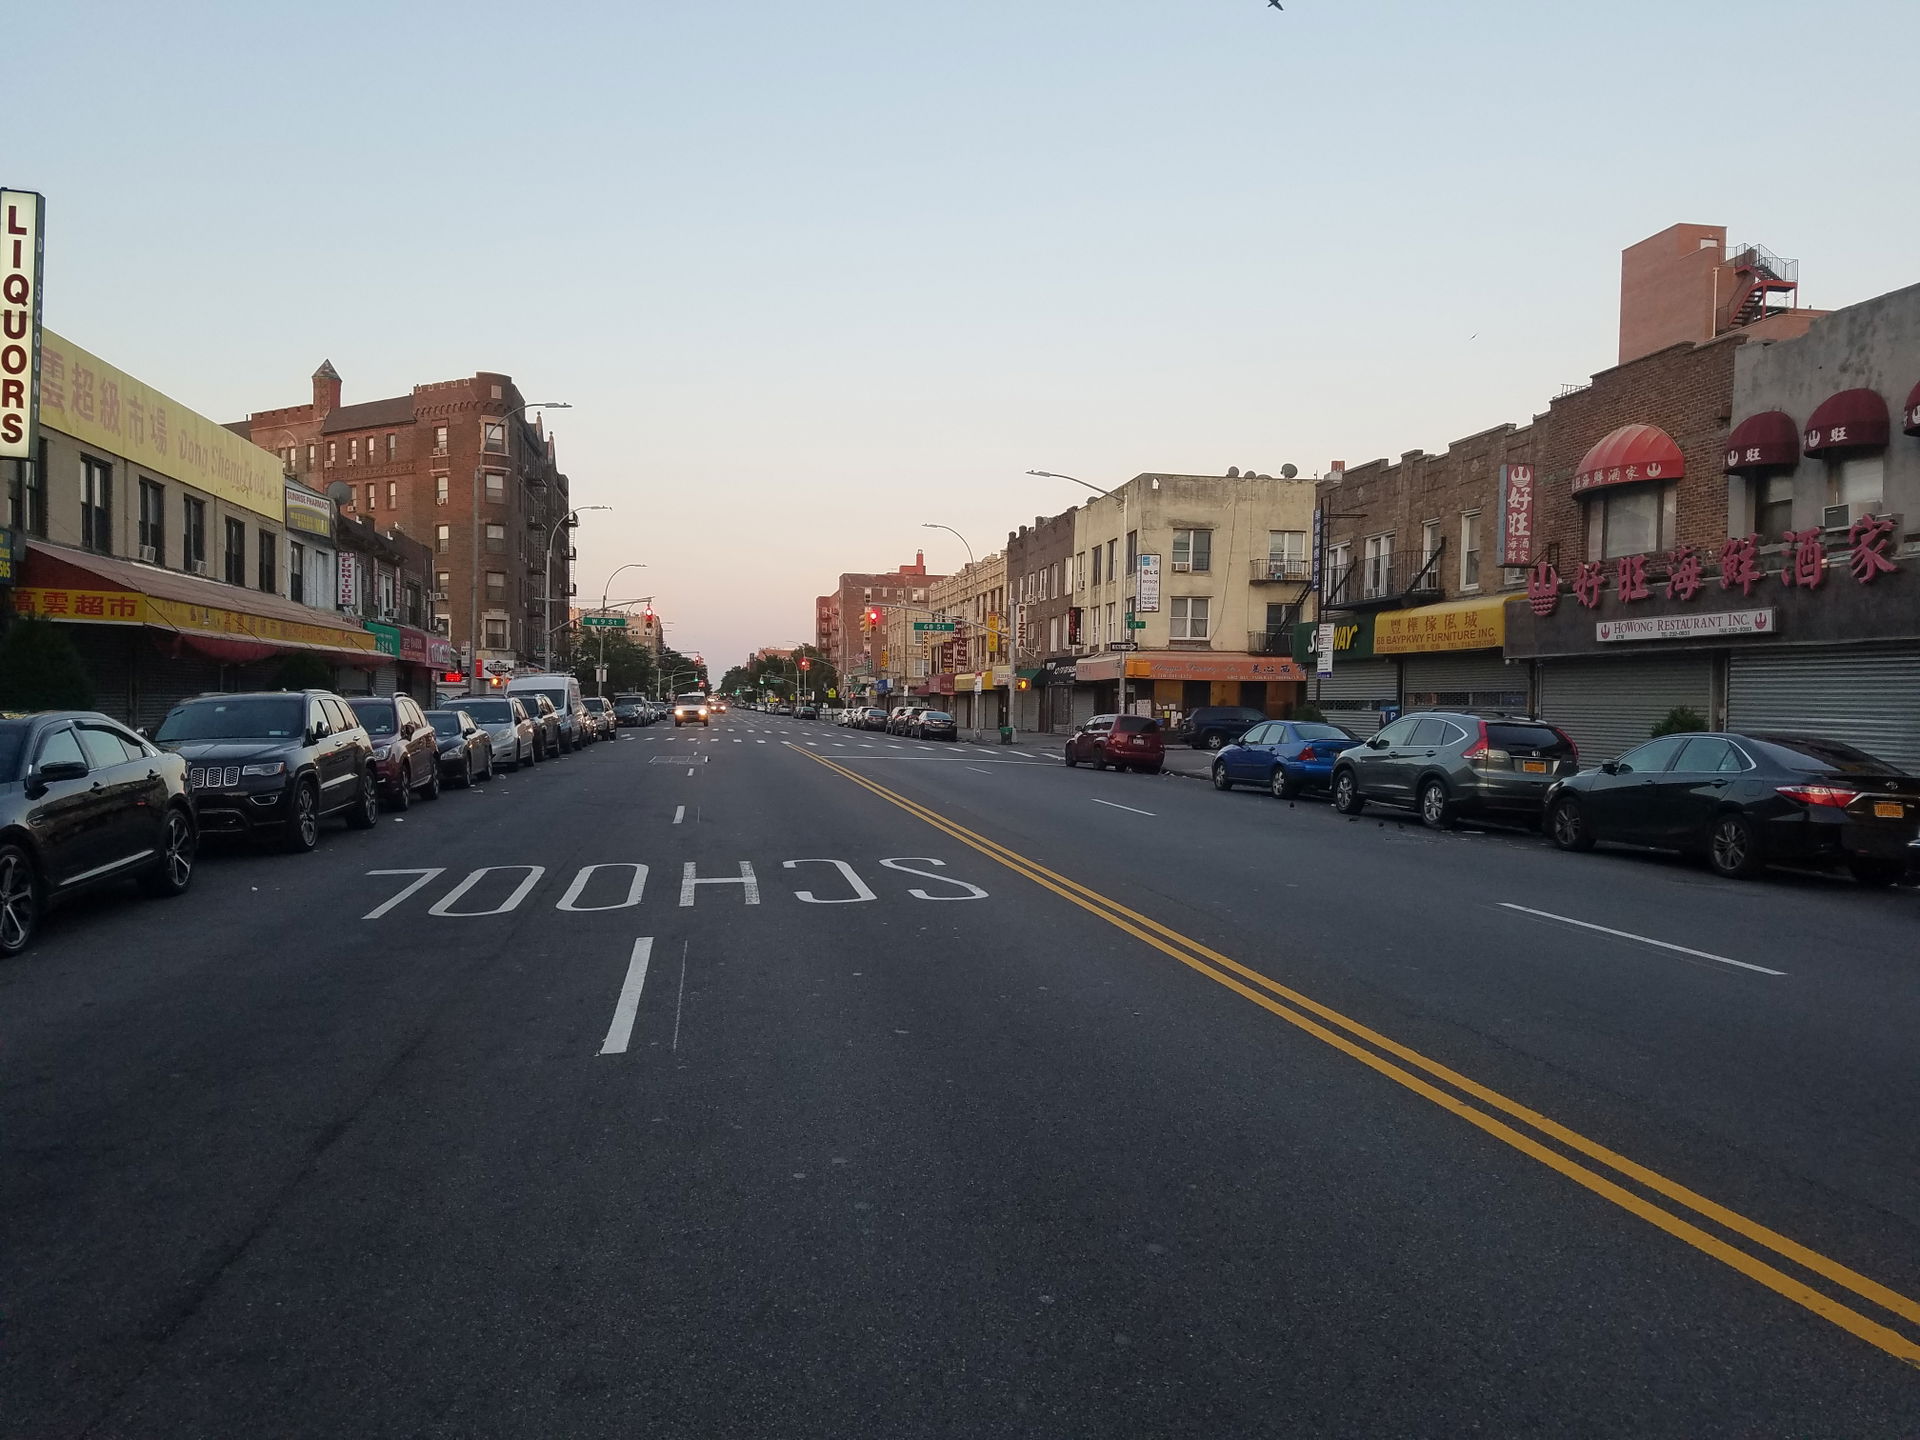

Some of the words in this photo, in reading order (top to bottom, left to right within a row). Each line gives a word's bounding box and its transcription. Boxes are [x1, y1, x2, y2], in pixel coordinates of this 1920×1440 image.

[1, 205, 30, 444] LIQUORS
[34, 237, 43, 419] DISCOUNT
[177, 428, 209, 477] Dong
[1745, 448, 1761, 462] 旺
[1829, 426, 1847, 442] 旺
[1507, 486, 1533, 536] 好旺
[342, 557, 352, 604] FURNITURE
[1573, 513, 1897, 609] 好旺海鮮酒家
[15, 590, 138, 617] 高雲超市
[1657, 616, 1723, 631] RESTAURANT
[1728, 614, 1750, 626] INC.
[1018, 605, 1026, 648] PIZZA
[1308, 623, 1358, 654] SWAY
[1386, 634, 1425, 645] BAYPKWY
[1426, 629, 1476, 642] FURNITURE
[1478, 627, 1496, 638] INC.
[1390, 711, 1397, 721] P
[361, 857, 990, 920] SCHOOL
